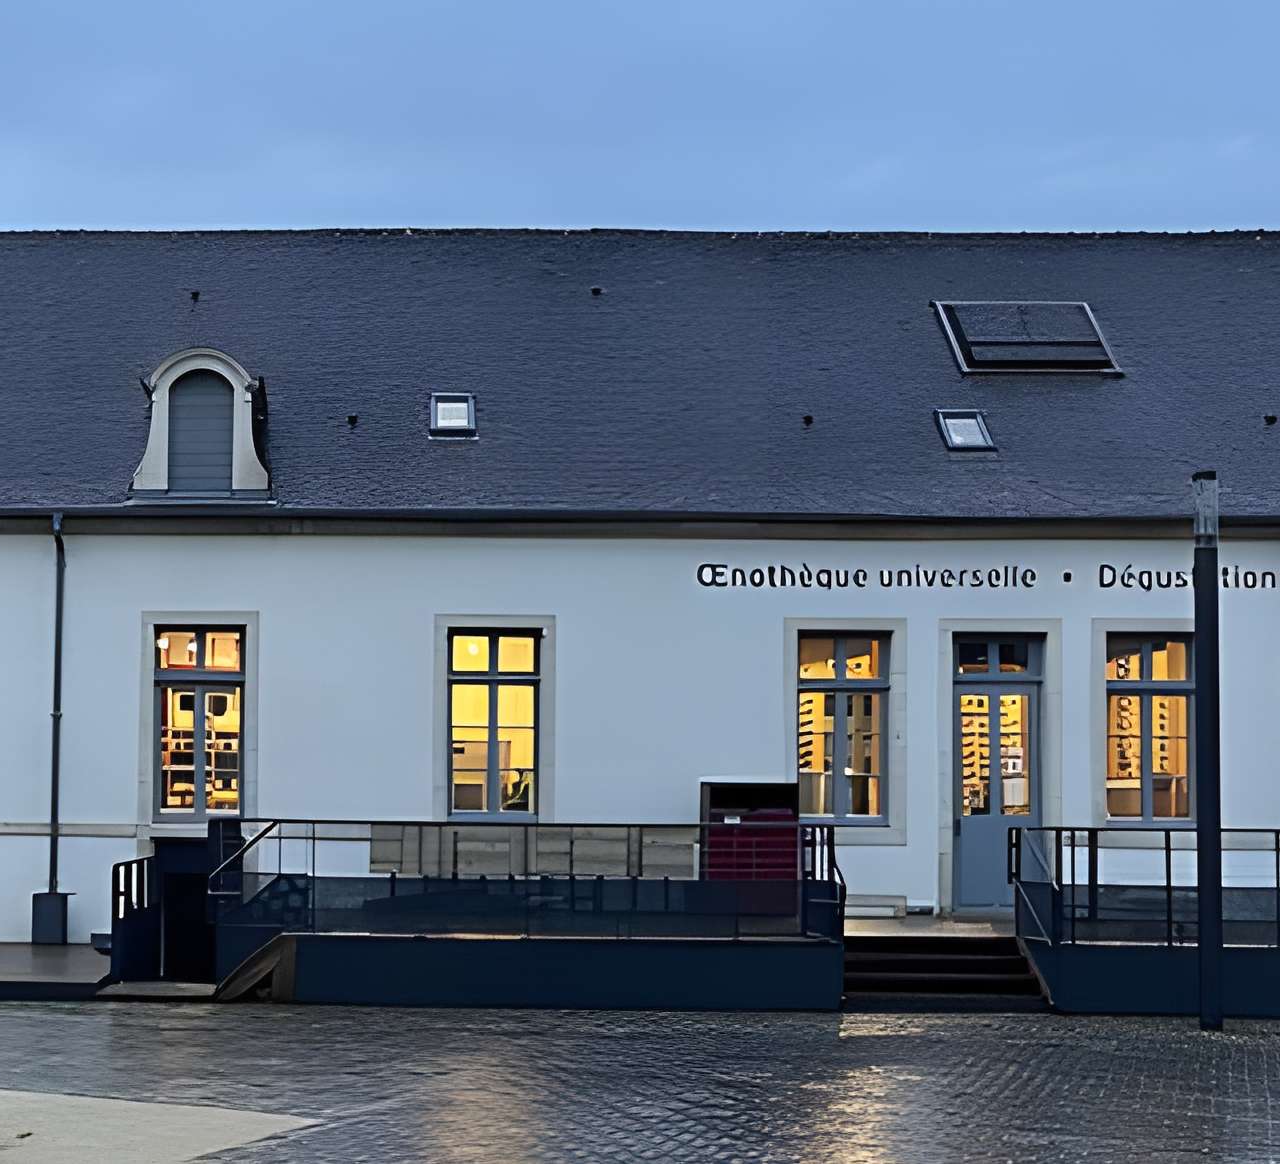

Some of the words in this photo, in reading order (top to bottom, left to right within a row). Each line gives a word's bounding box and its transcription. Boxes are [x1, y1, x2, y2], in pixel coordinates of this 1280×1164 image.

[696, 562, 868, 591] Œnothèque
[879, 563, 1037, 588] universelle
[1099, 563, 1276, 592] Dégustion
